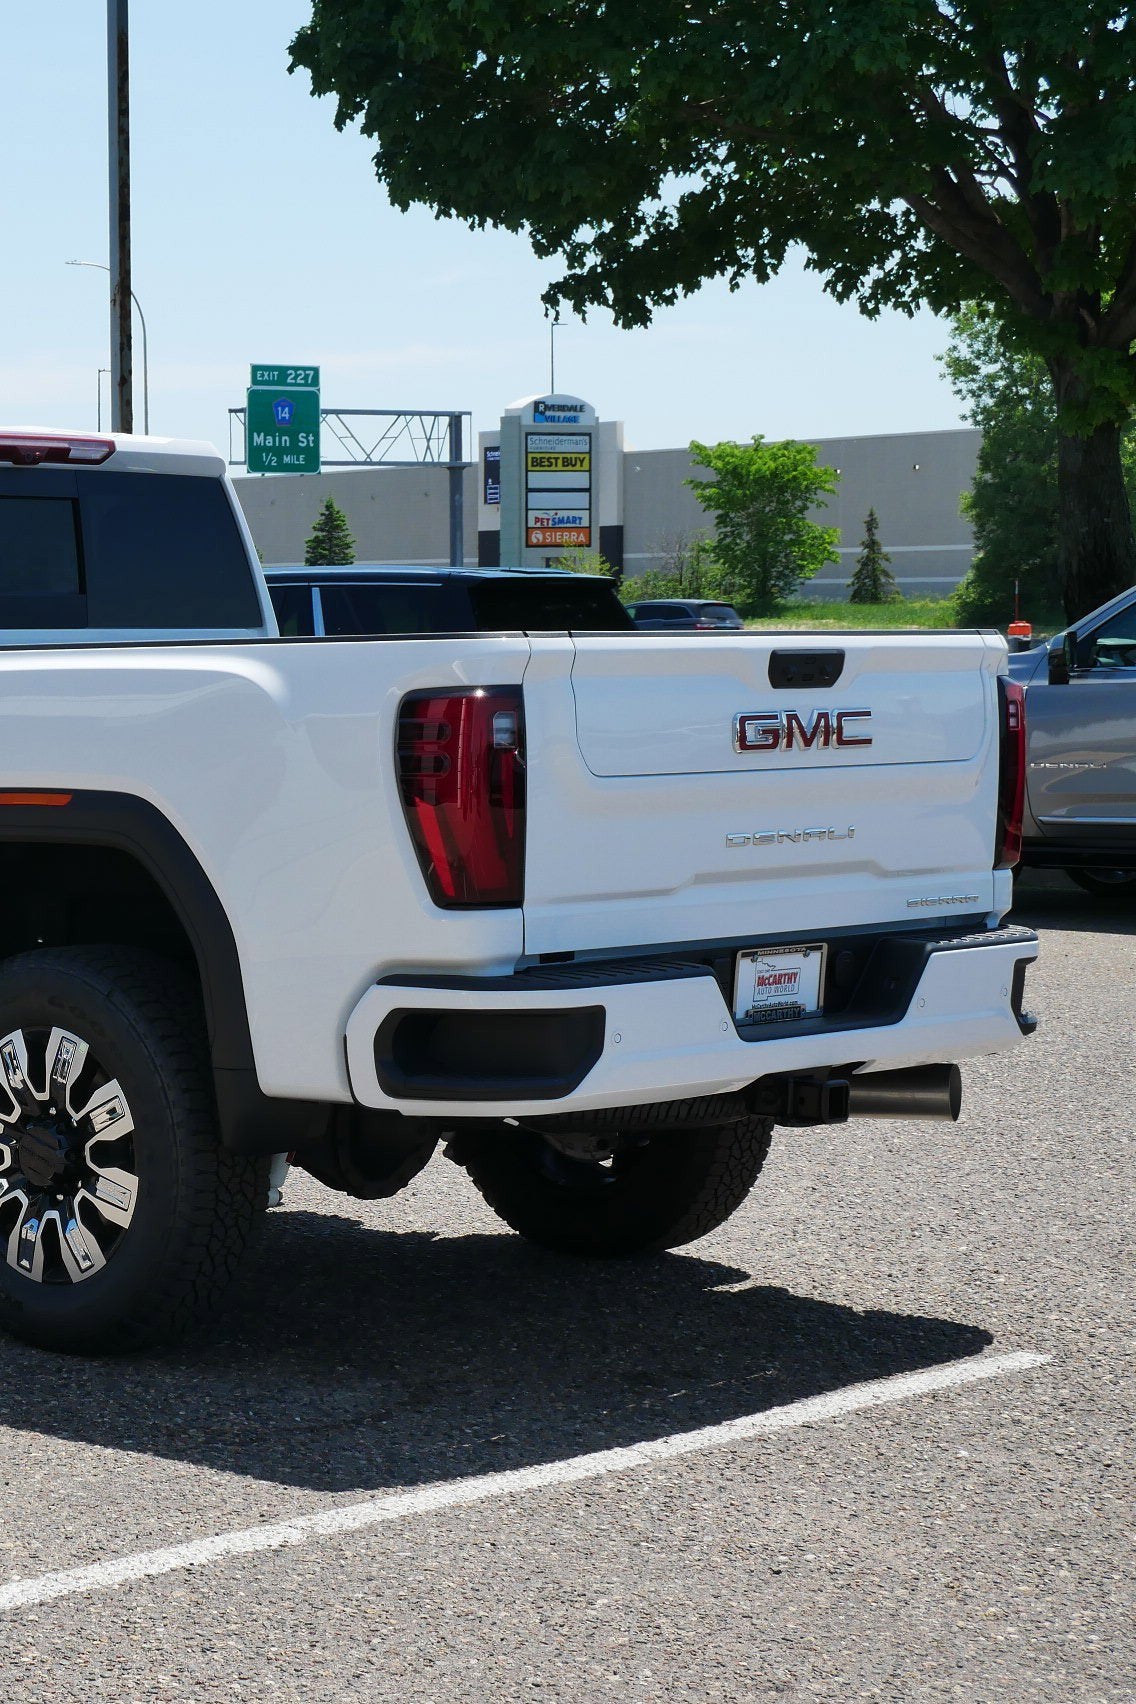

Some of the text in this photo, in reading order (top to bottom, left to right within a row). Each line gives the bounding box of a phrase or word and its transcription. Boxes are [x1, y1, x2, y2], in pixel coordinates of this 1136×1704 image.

[257, 370, 314, 384] EXIT 227
[277, 406, 290, 420] 14
[537, 403, 586, 413] RIVERDALE
[545, 415, 581, 424] VILLAGE
[253, 432, 315, 447] Main St
[529, 437, 588, 446] Schneiderman's
[283, 455, 306, 464] MILE
[531, 456, 586, 468] BEST BUY
[546, 533, 586, 543] SIERRA
[732, 708, 872, 753] GMC
[725, 825, 855, 848] DENALI
[906, 894, 980, 908] SIERRA
[757, 947, 806, 956] MINNESOTA
[757, 972, 798, 987] McCARTHY
[757, 984, 795, 996] AUTO WORLD
